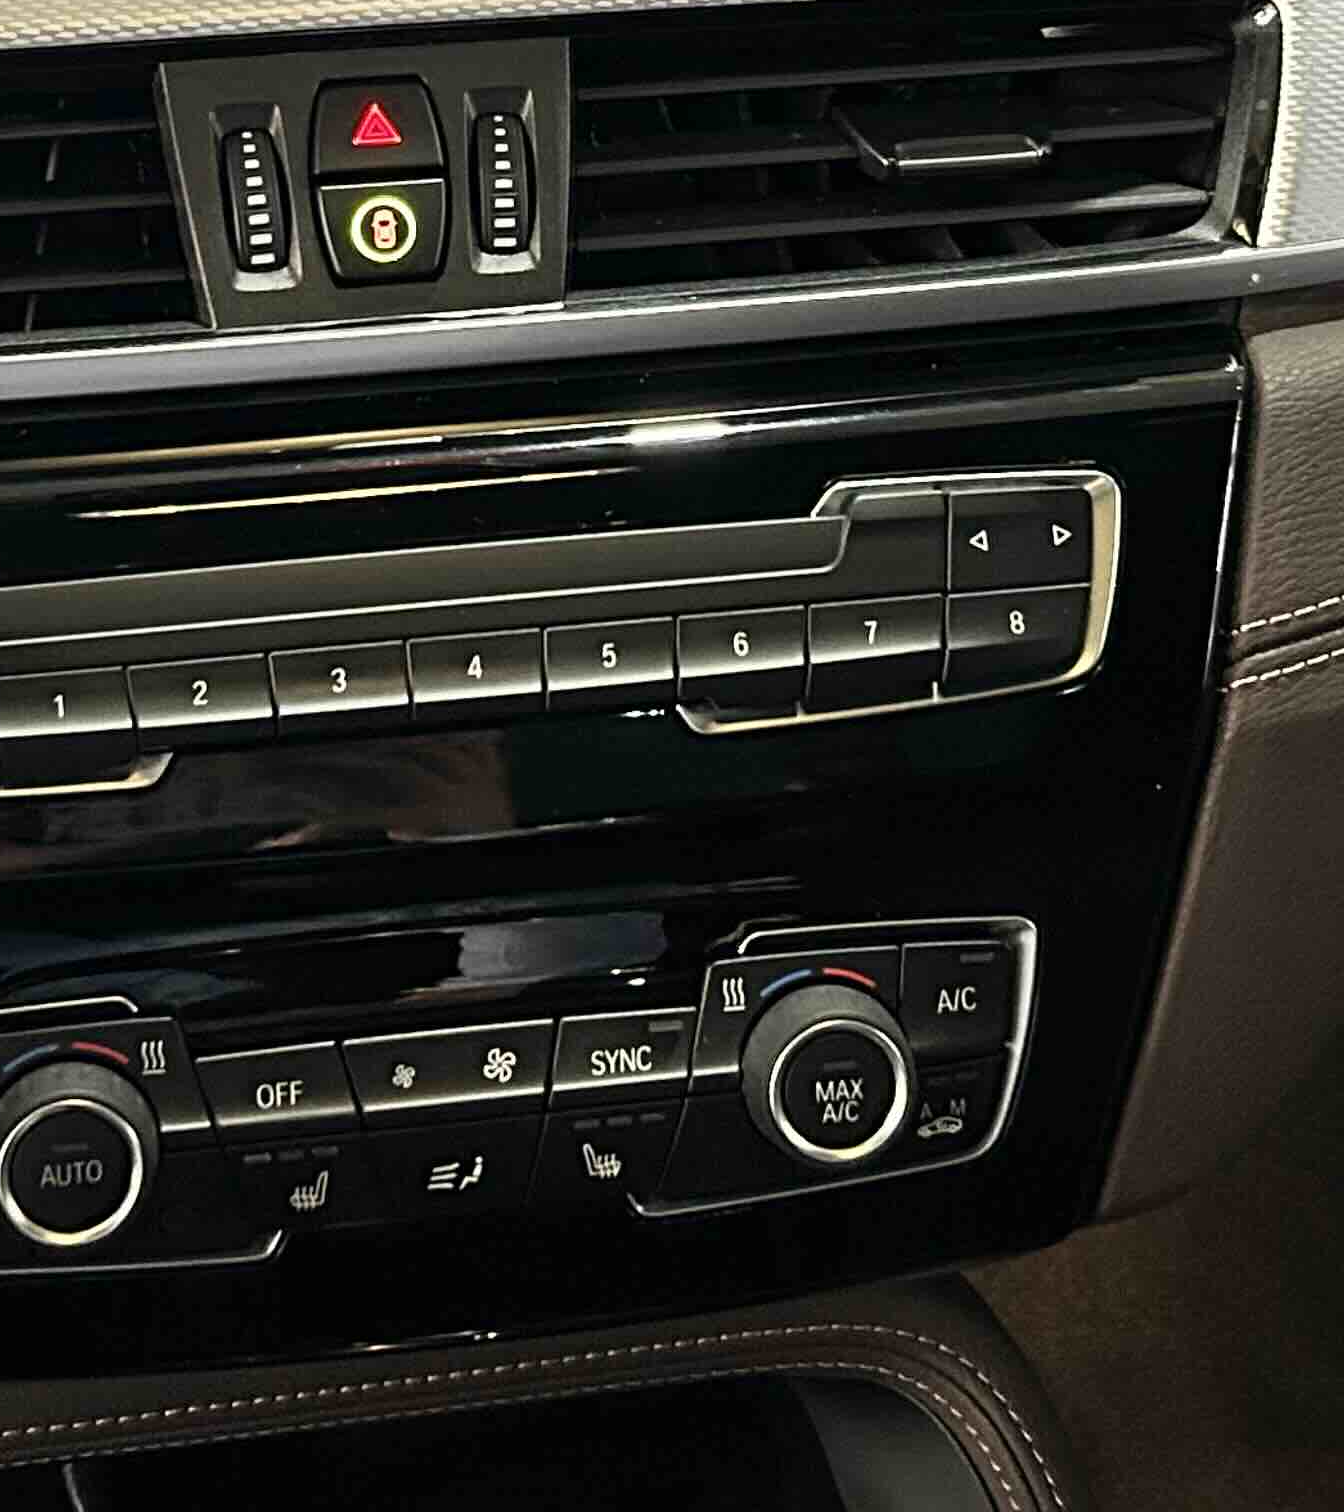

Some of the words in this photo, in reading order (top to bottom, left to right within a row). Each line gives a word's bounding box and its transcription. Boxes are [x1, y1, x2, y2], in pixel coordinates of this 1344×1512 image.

[52, 693, 66, 719] 1
[191, 679, 209, 706] 2
[328, 664, 350, 696] 3
[464, 652, 485, 682] 4
[599, 639, 618, 671] 5
[730, 627, 751, 659] 6
[862, 616, 879, 648] 7
[1006, 608, 1027, 638] 8
[937, 986, 977, 1014] A/C
[590, 1044, 653, 1076] SYNC
[255, 1080, 305, 1110] OFF
[815, 1078, 864, 1101] MAX
[817, 1100, 859, 1123] A/C
[40, 1159, 103, 1187] AUTO
